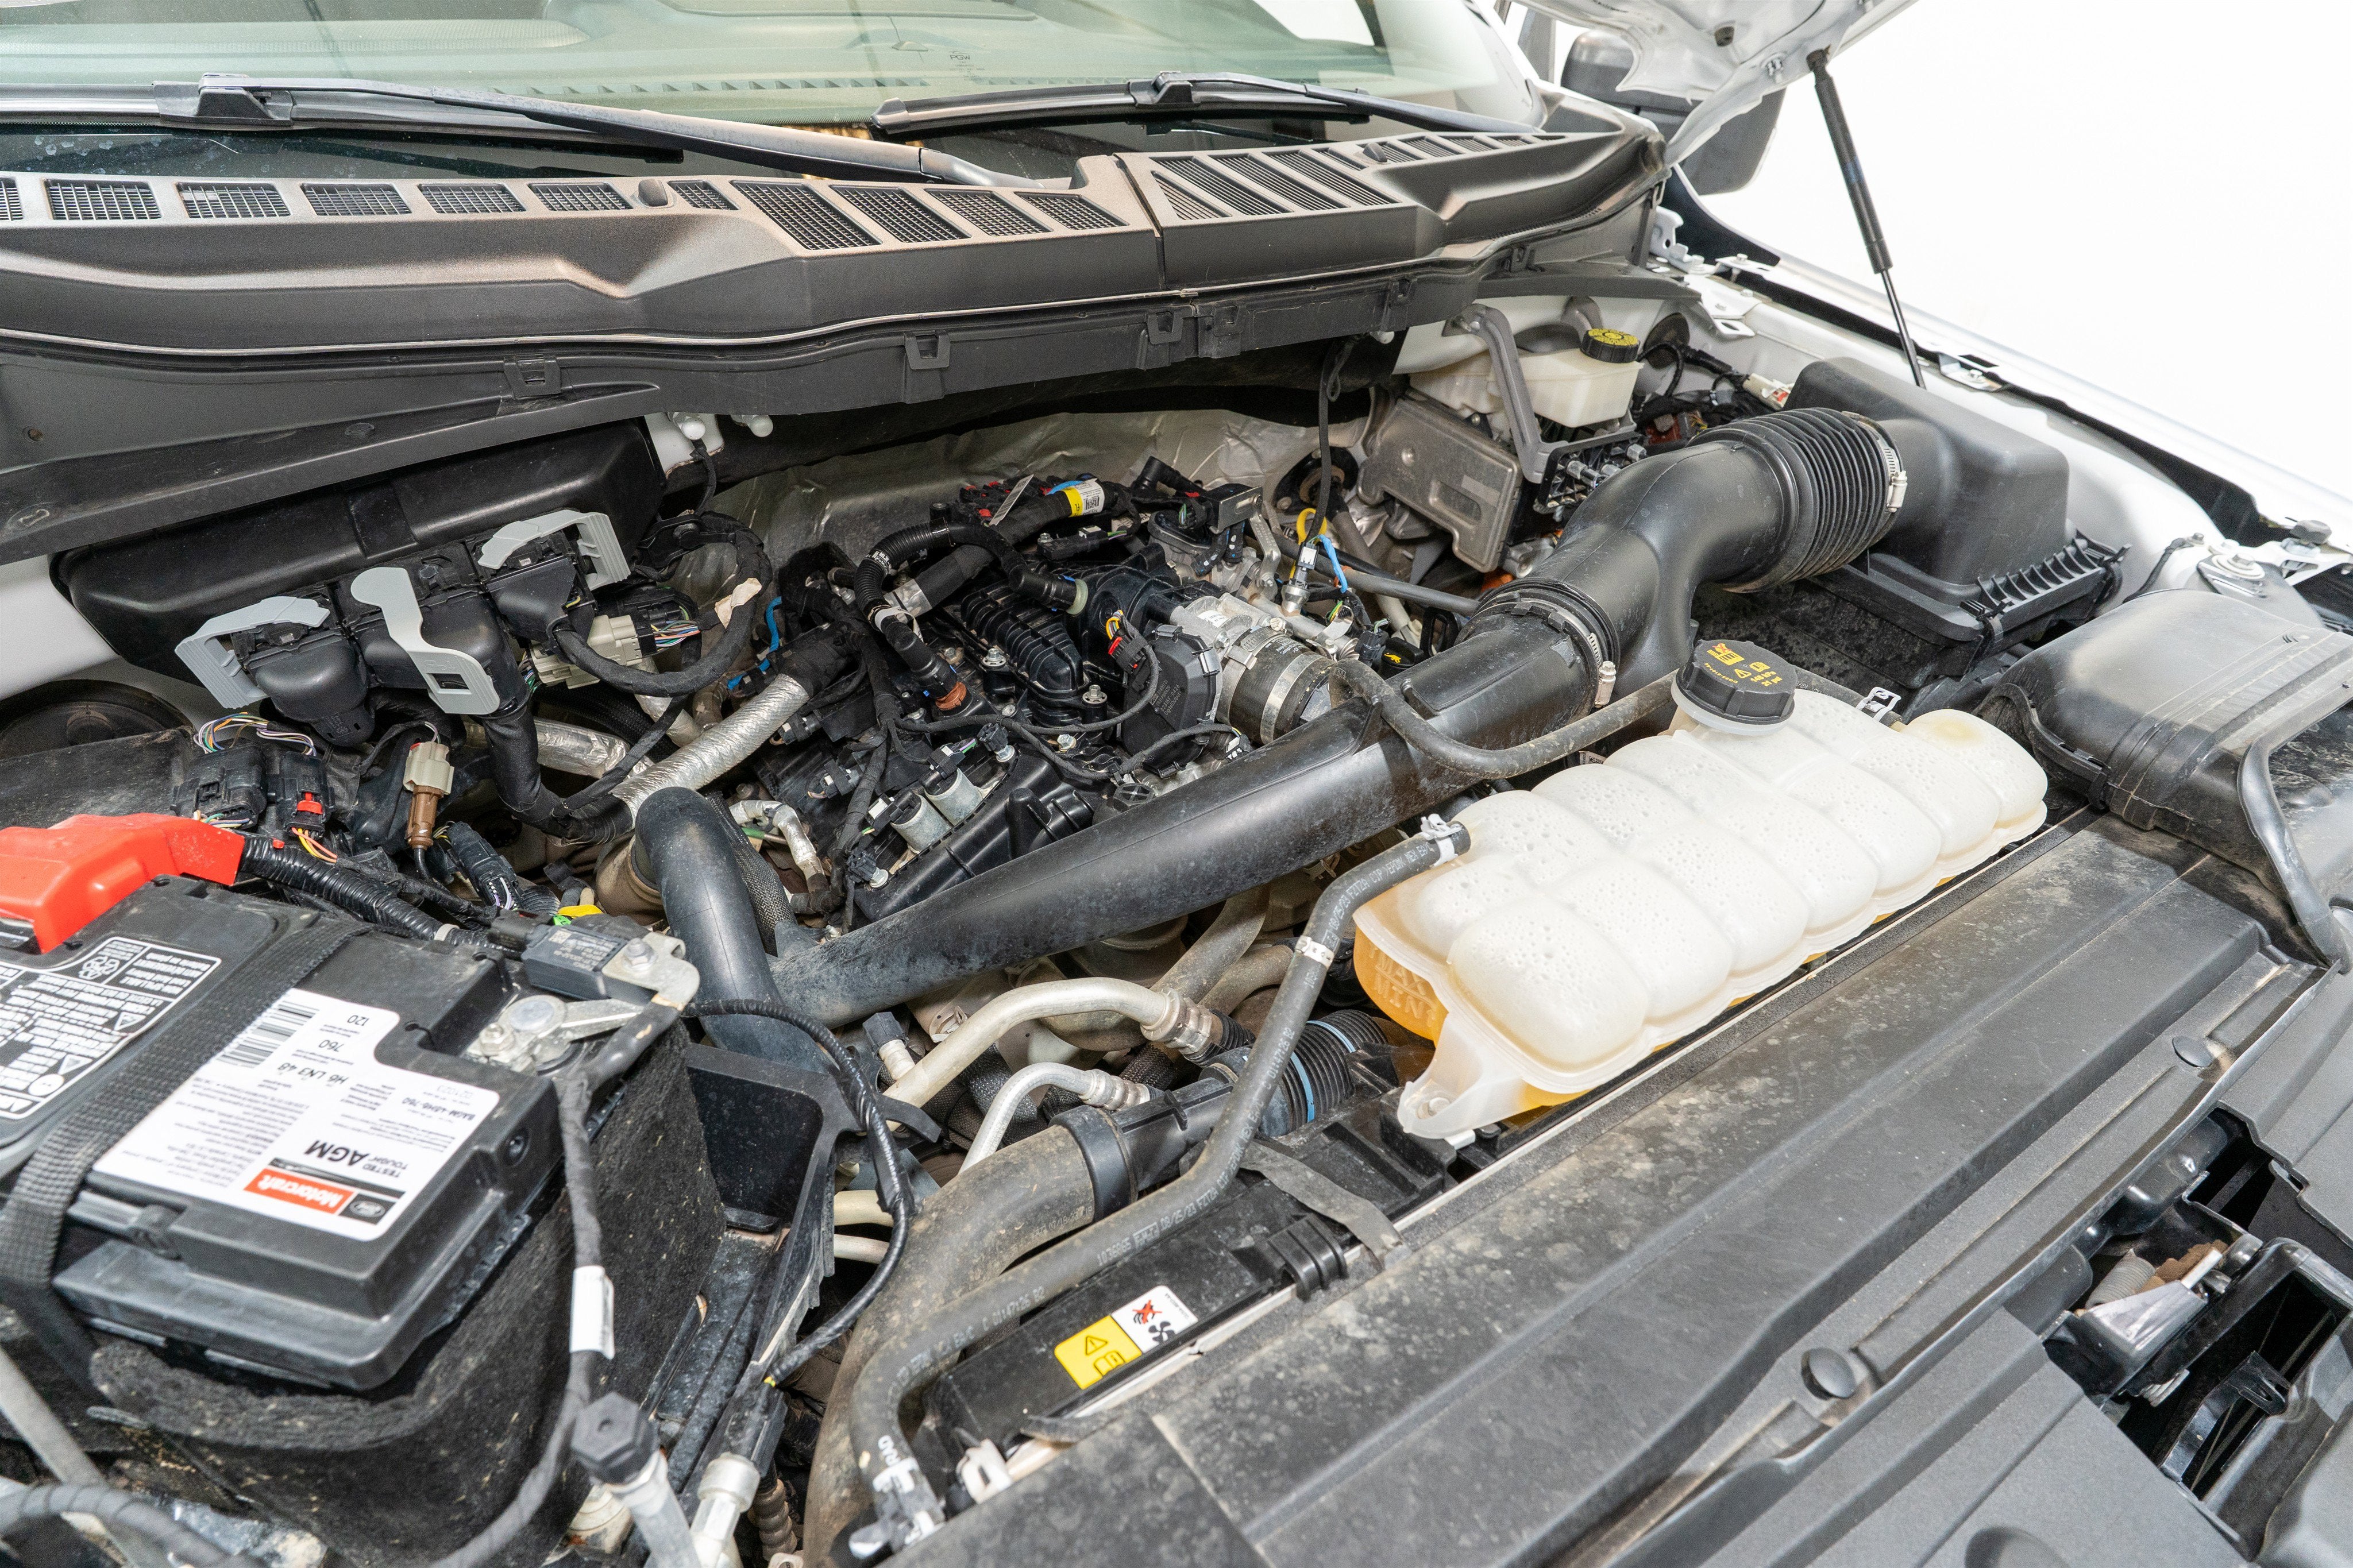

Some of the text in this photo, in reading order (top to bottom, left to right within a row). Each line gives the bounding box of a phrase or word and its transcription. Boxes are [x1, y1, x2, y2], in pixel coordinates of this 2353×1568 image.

[1374, 972, 1424, 1019] MIN
[347, 1015, 369, 1026] 120
[318, 1040, 343, 1052] 760
[277, 1063, 348, 1083] H6 LN3 48
[305, 1141, 368, 1165] AGM
[362, 1164, 399, 1177] TESTED
[259, 1176, 342, 1206] Motorcraft
